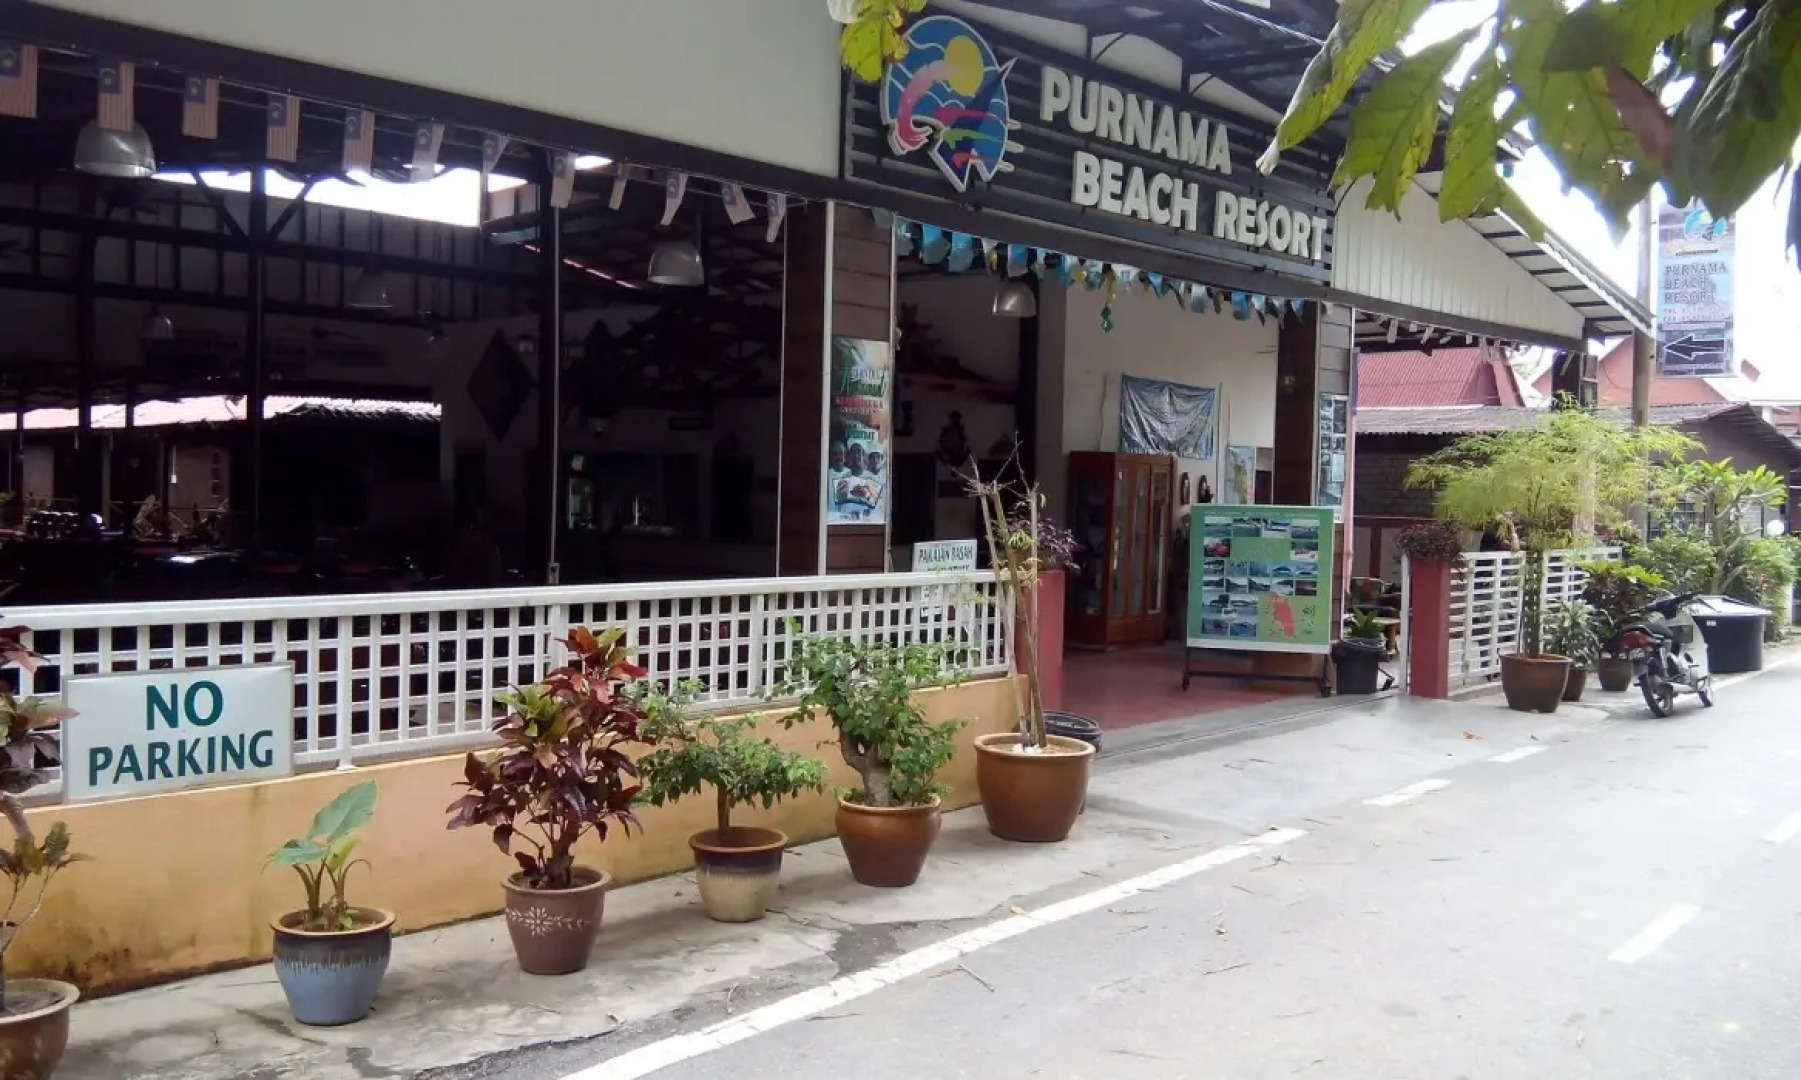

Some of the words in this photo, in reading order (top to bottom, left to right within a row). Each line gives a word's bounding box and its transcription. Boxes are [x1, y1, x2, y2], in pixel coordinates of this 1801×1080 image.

[1040, 66, 1232, 175] PURNAMA
[1071, 151, 1199, 231] BEACH
[1213, 190, 1328, 260] RESORT
[1665, 262, 1728, 275] PURNAMA
[1665, 276, 1709, 290] BEACH
[1665, 291, 1716, 303] RESORT
[146, 680, 223, 731] NO
[88, 730, 273, 786] PARKING
